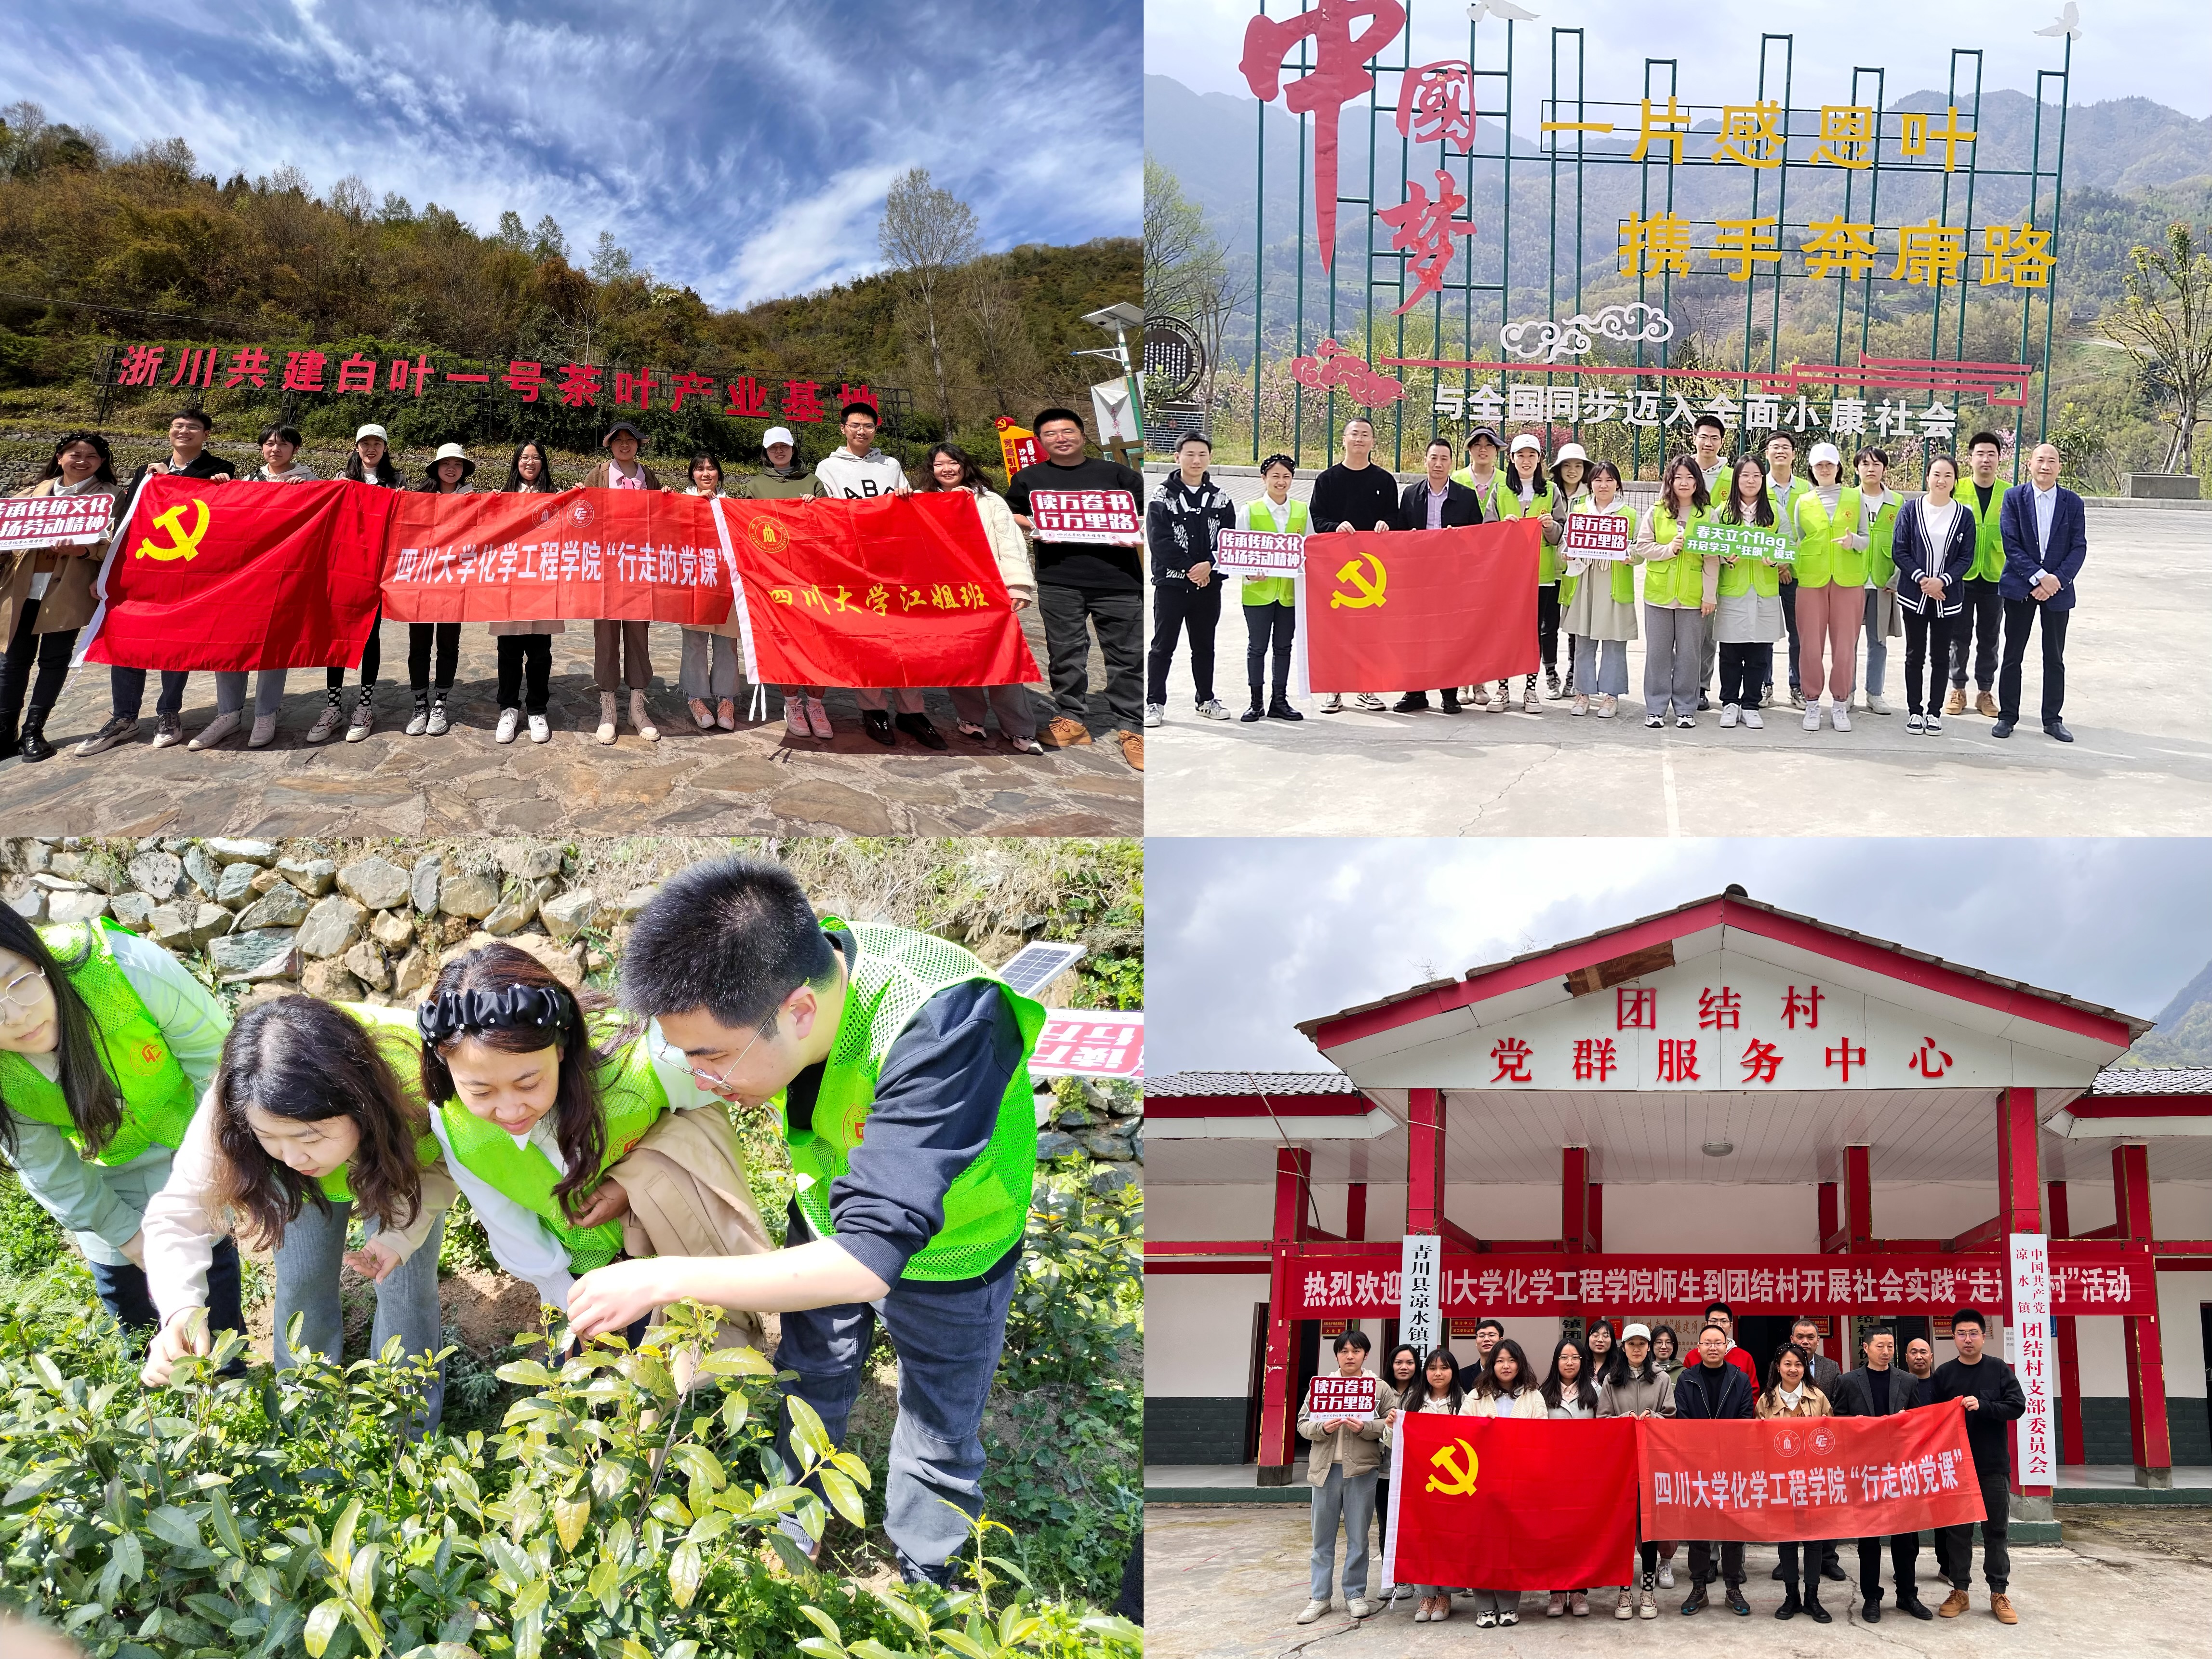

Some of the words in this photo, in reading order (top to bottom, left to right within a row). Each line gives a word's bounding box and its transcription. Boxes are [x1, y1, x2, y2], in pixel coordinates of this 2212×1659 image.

[1541, 96, 1977, 172] 一片感恩叶
[1618, 211, 2058, 288] 携手奔康路
[118, 345, 883, 427] 浙川共建白叶一号茶叶产业基地
[1434, 384, 1959, 439] 与全国同步迈入全面小康社会
[1036, 494, 1131, 510] 读万卷书
[1039, 512, 1135, 530] 行万里路
[1571, 516, 1626, 533] 读万卷书
[0, 515, 107, 537] 扬劳动精神
[1222, 532, 1300, 551] 传承传统文化
[1570, 531, 1625, 549] 行万里路
[1696, 525, 1786, 549] 春天立个flag
[393, 540, 728, 588] 四川大学化学工程学院“行走的党课”
[1221, 549, 1300, 567] 弘扬劳动精神
[767, 581, 991, 617] 四川大学江姐班
[1616, 985, 1825, 1030] 团结村
[1490, 1036, 1953, 1083] 党群服务中心
[2015, 1248, 2030, 1314] 凉水镇
[2031, 1248, 2046, 1314] 中国共产党
[1408, 1244, 1433, 1371] 青川县凉水镇团
[1313, 1395, 1373, 1410] 行万里路
[1314, 1379, 1374, 1394] 读万卷书
[2022, 1322, 2048, 1474] 团结村支部委员会
[1654, 1448, 1963, 1510] 四川大学化学工程学院“行走的党课”
